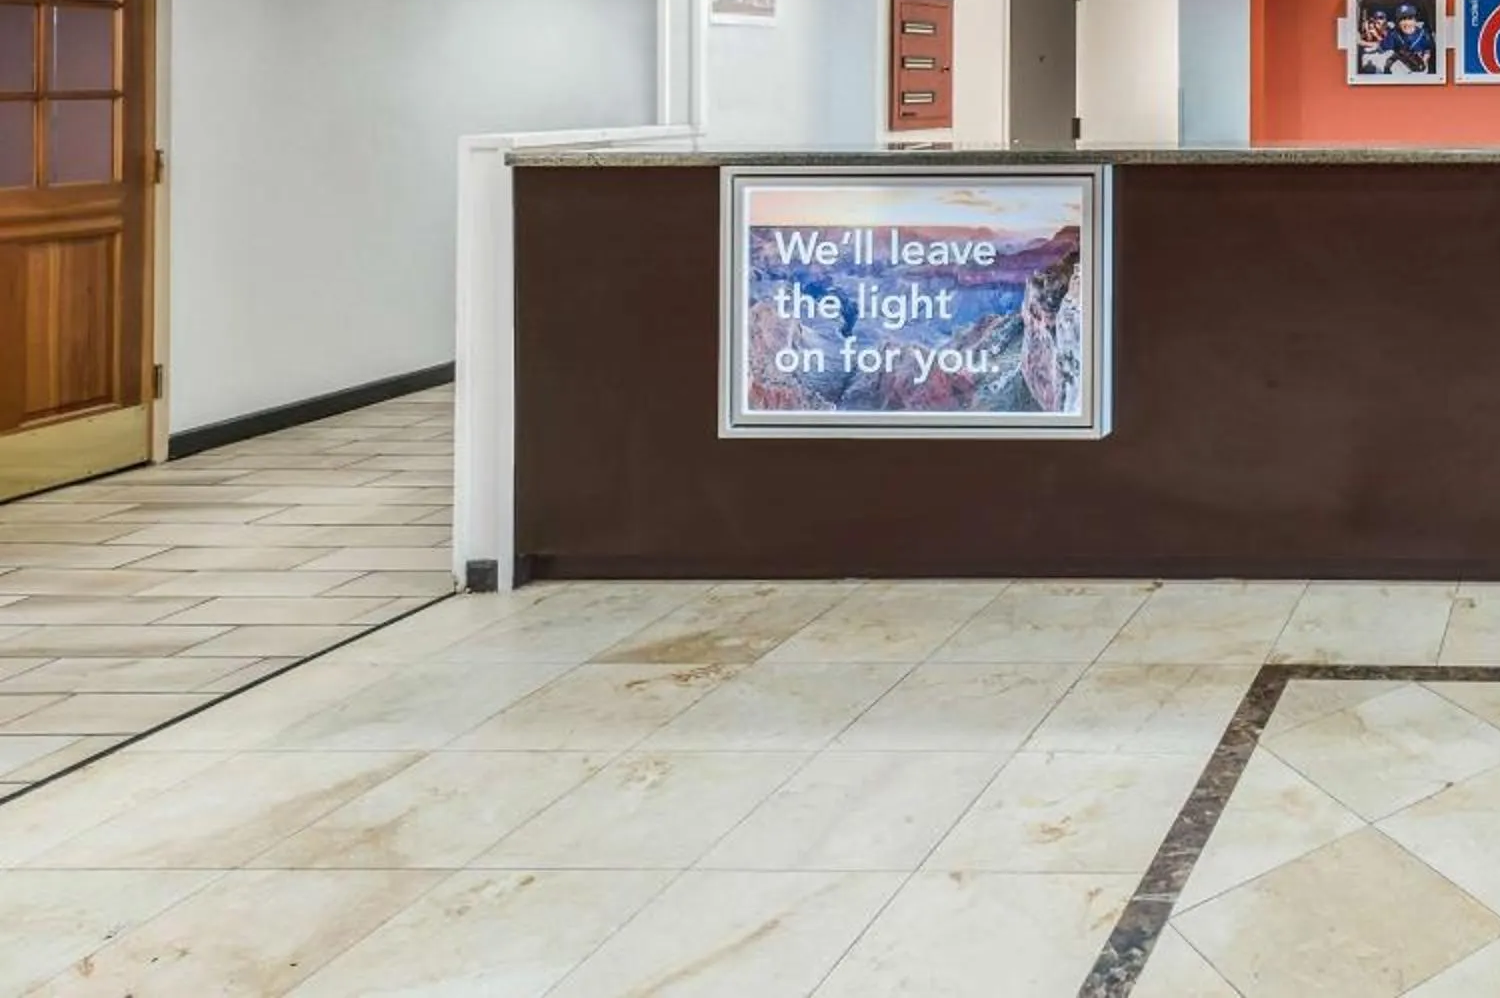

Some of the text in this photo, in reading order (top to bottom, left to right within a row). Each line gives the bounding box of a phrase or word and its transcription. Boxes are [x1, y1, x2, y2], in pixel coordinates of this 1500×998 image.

[775, 228, 996, 265] We'll leave
[774, 282, 952, 329] the light
[775, 347, 825, 373] on
[841, 336, 901, 373] for
